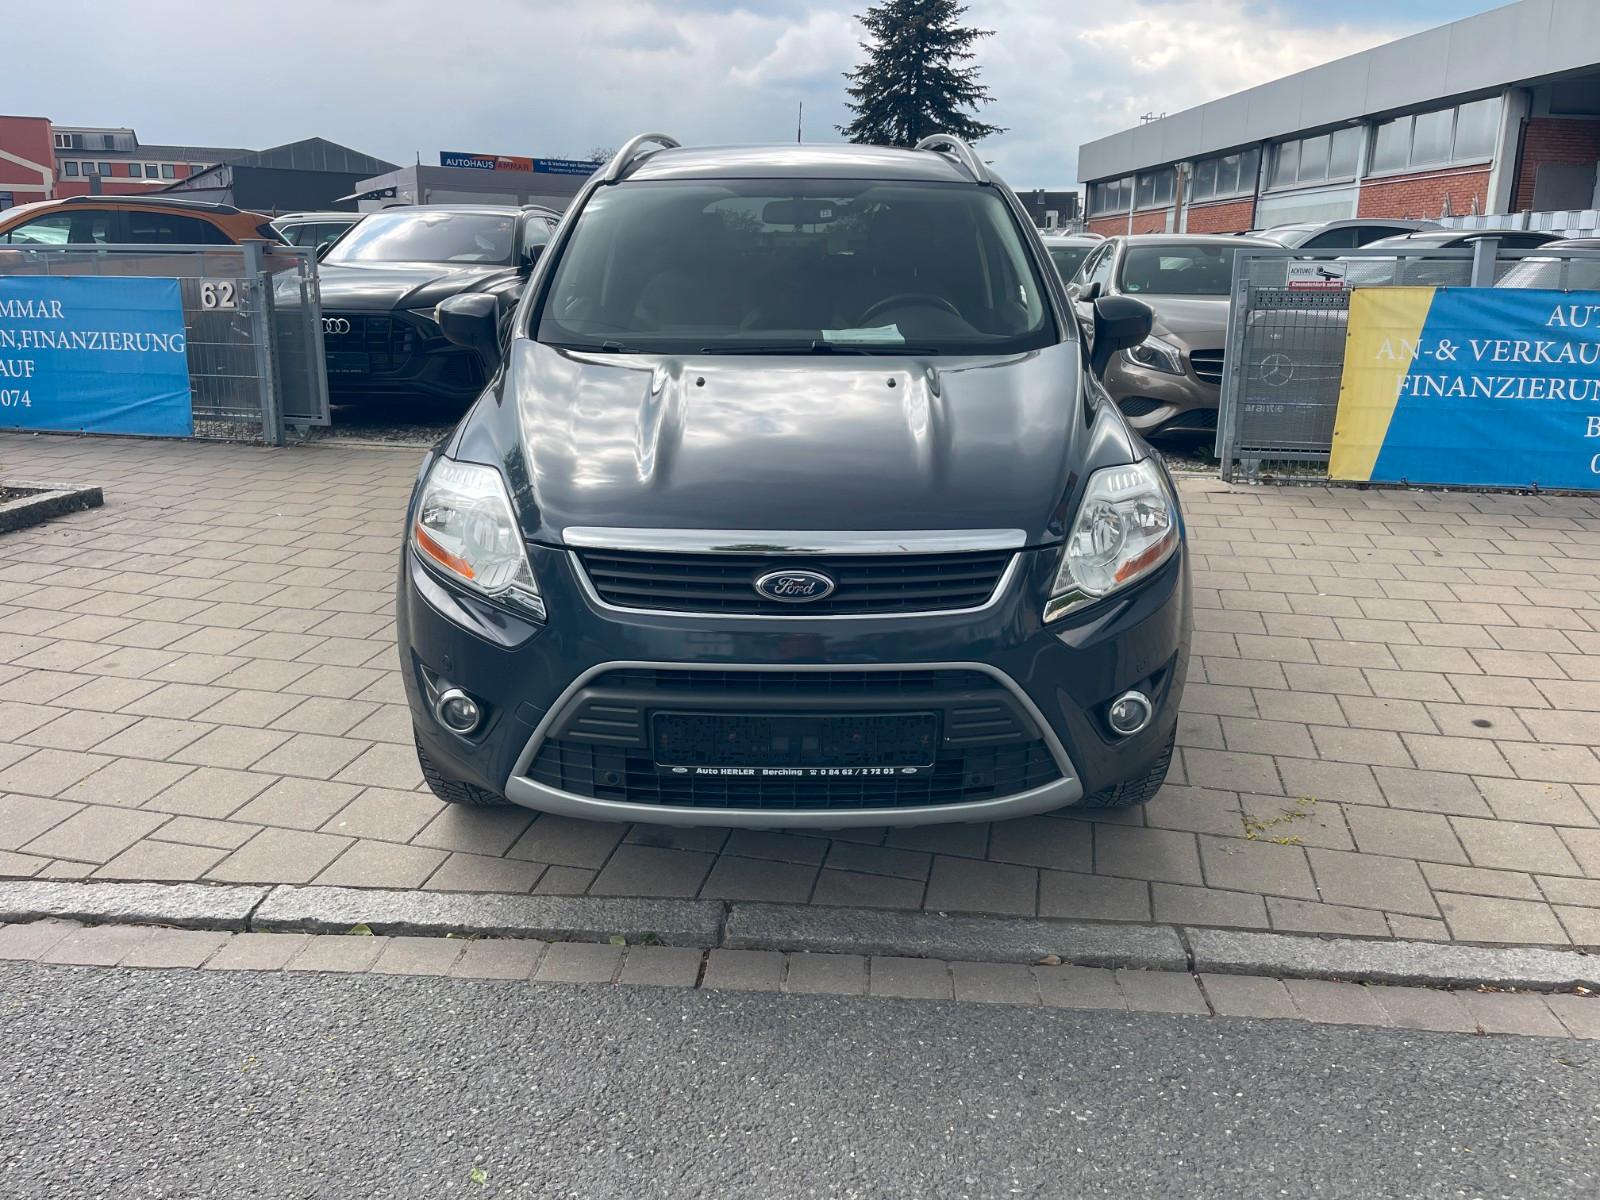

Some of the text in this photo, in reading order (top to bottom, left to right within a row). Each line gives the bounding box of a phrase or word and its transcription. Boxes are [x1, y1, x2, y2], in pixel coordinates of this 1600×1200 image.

[446, 158, 529, 171] AUTOHAUS AMMAR
[201, 282, 235, 308] 62
[0, 329, 185, 353] N,FINANZIERUNG
[774, 577, 816, 595] Ford
[696, 767, 718, 775] Auto
[720, 768, 755, 776] HERLER
[762, 768, 802, 776] Berching
